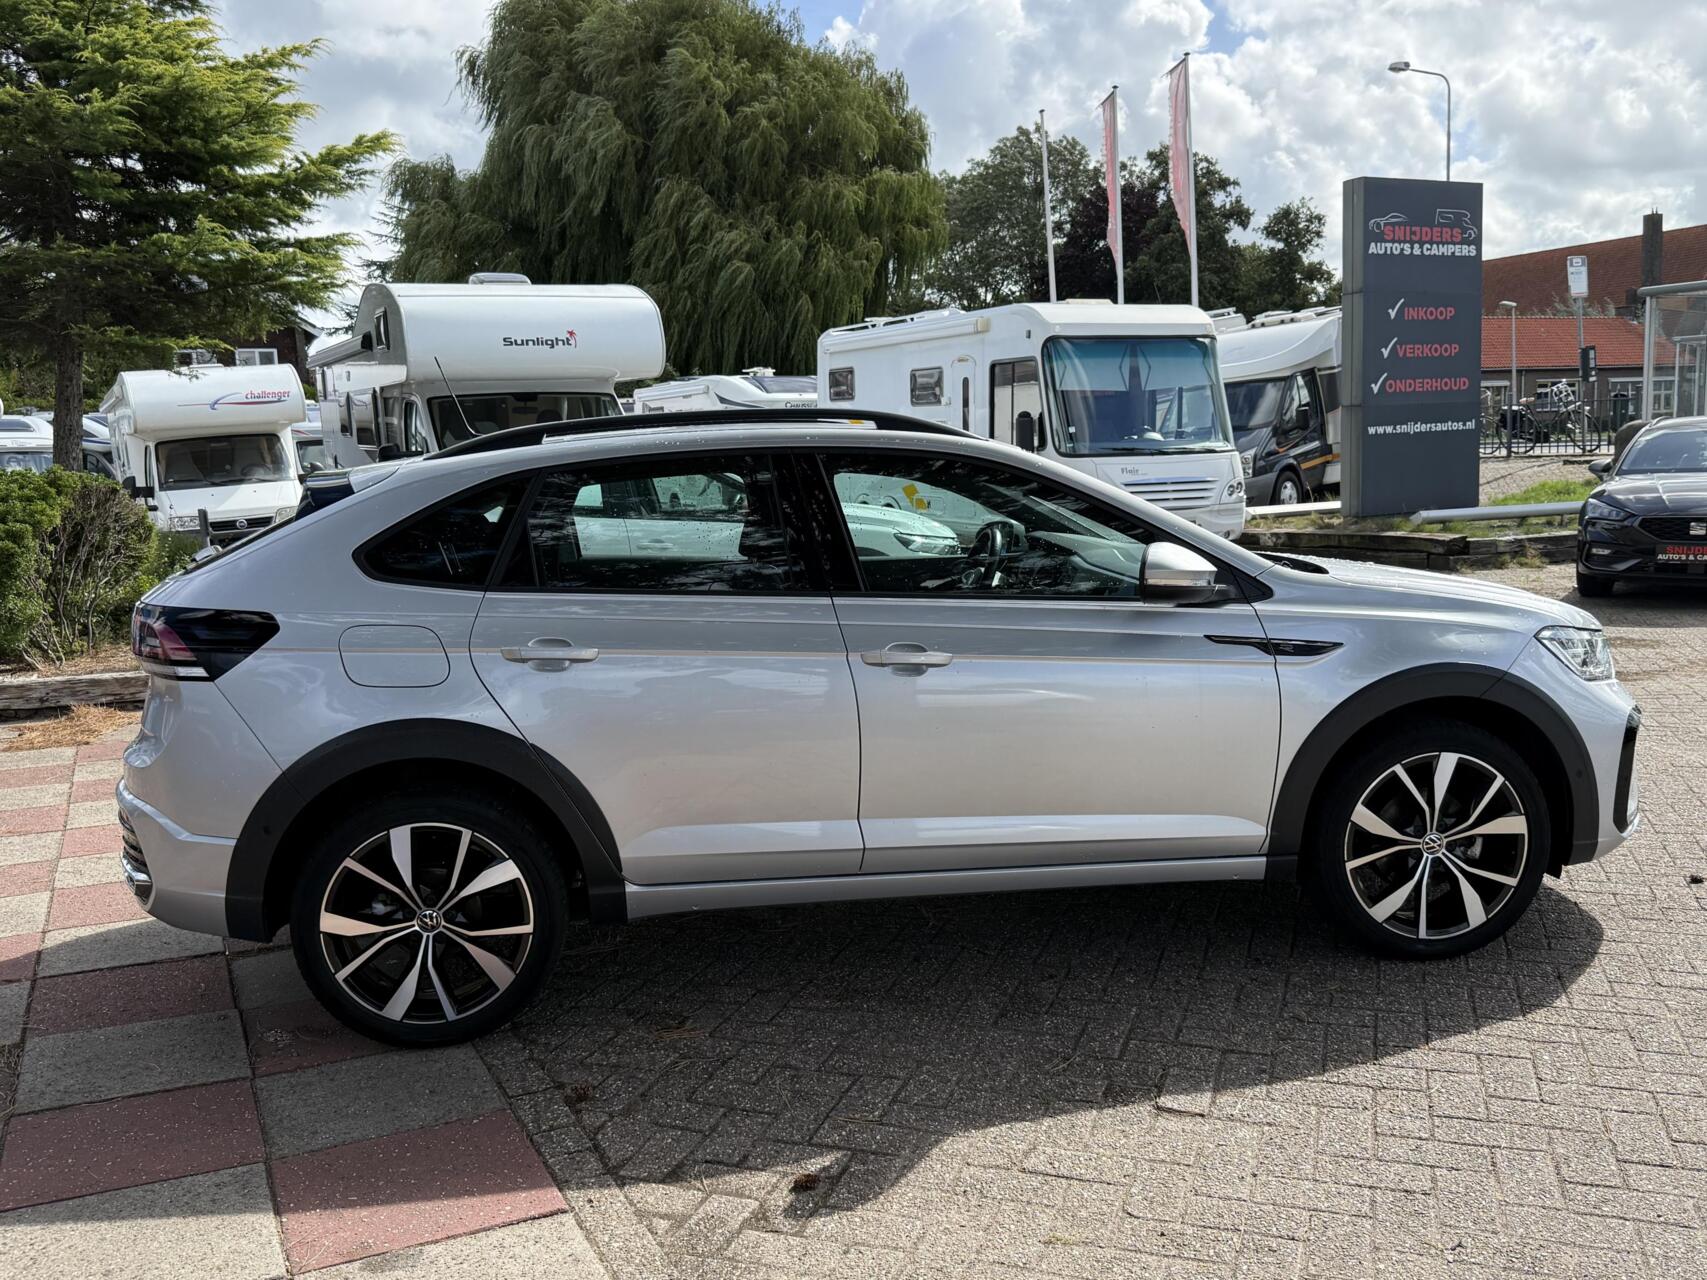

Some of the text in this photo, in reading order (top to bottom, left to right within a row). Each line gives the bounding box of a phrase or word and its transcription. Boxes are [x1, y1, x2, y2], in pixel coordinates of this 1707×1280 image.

[1383, 225, 1462, 242] SNIJDERS
[1368, 242, 1477, 256] AUTO'S & CAMPERS
[1404, 307, 1455, 320] INKOOP
[502, 336, 573, 349] Sunlight
[1396, 344, 1459, 357] VERKOOP
[1385, 377, 1469, 392] ONDERHOUD
[244, 389, 291, 401] challenger
[1367, 419, 1476, 435] www.snijdersautos.nl
